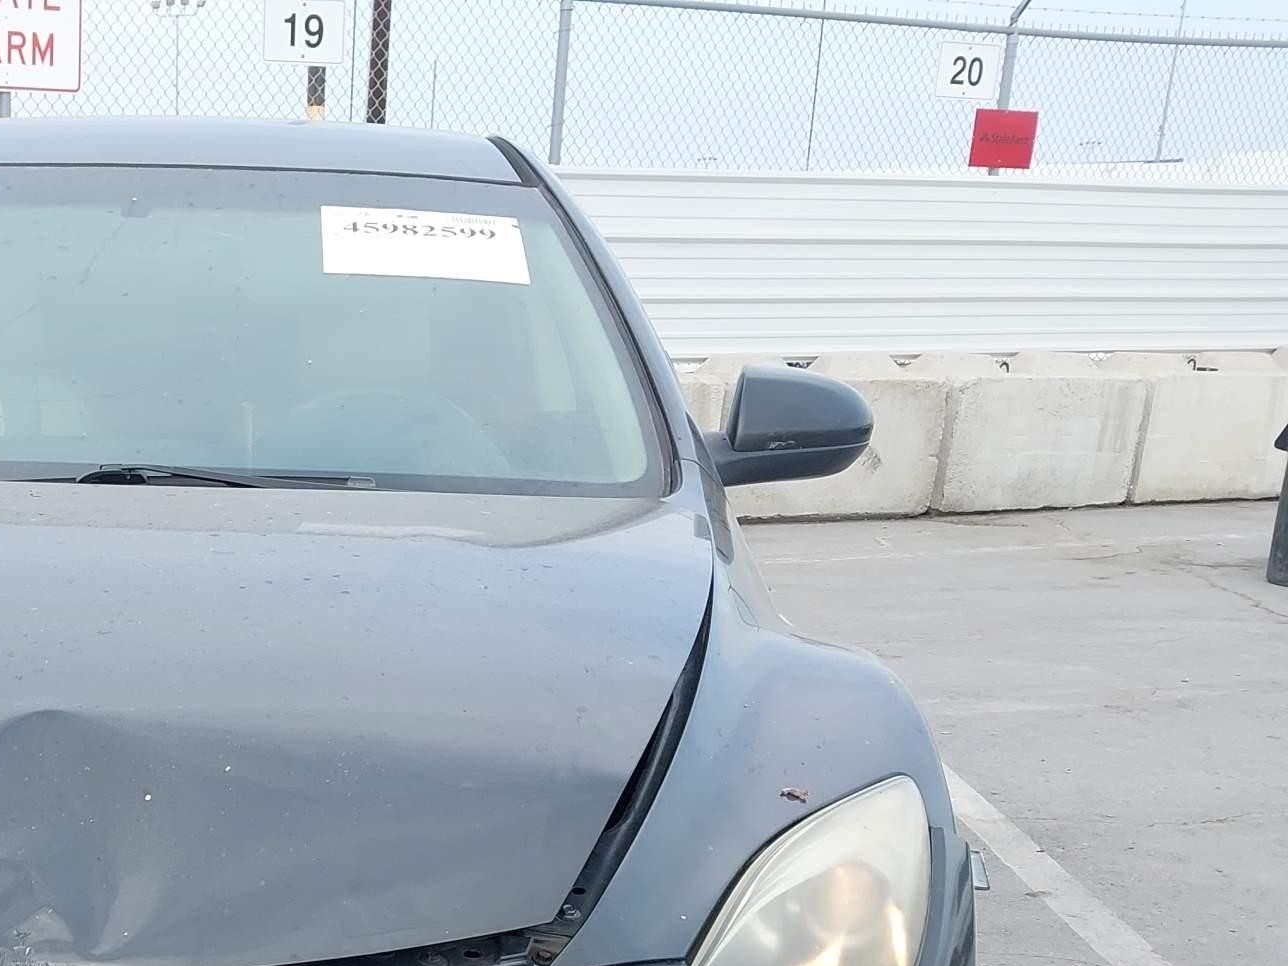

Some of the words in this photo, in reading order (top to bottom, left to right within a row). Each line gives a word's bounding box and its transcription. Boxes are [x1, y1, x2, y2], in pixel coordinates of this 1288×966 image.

[284, 13, 324, 48] 19
[950, 56, 983, 86] 20
[344, 221, 496, 239] 45982599
